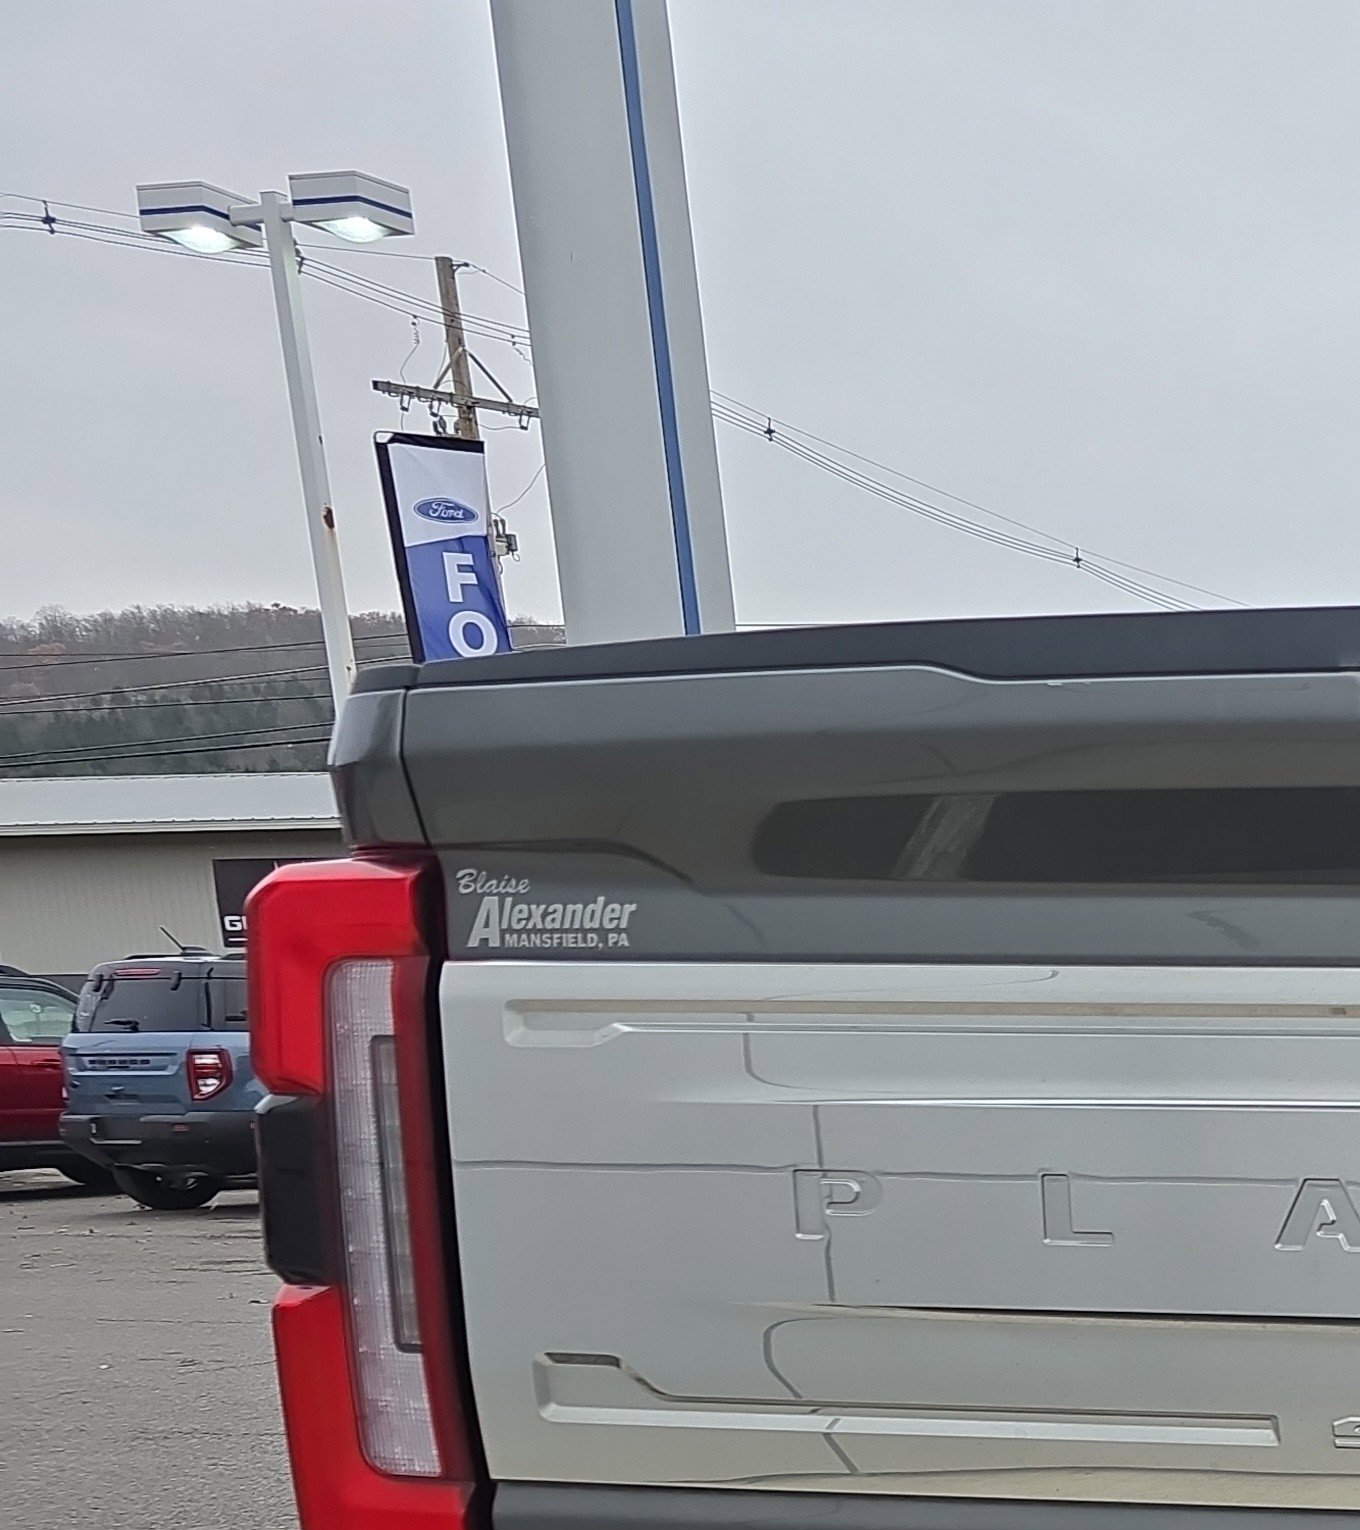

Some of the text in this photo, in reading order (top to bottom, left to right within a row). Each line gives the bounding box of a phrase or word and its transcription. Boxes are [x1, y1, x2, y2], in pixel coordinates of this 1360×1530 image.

[429, 501, 466, 520] Ford
[456, 868, 531, 895] Blaise
[466, 896, 638, 948] Alexander
[504, 933, 630, 950] MANSFIELD, PA
